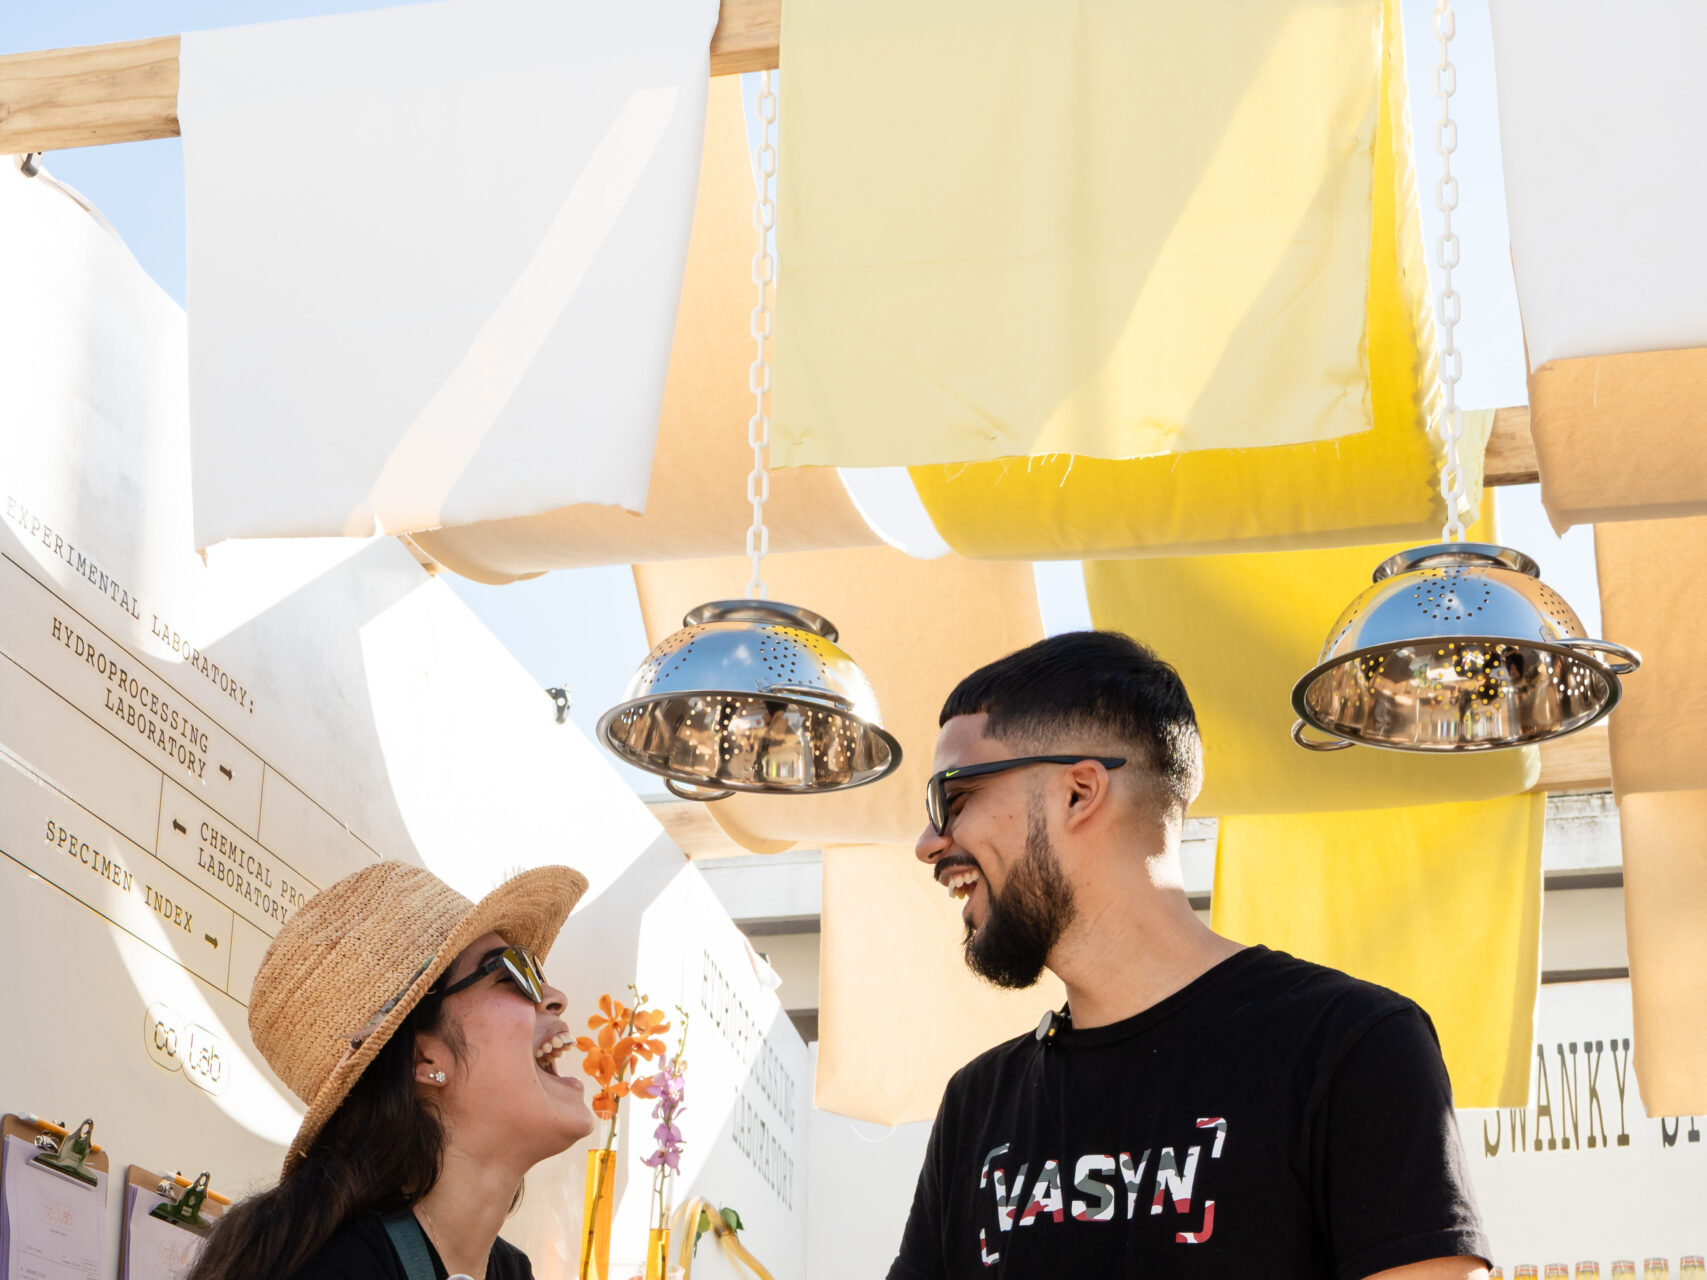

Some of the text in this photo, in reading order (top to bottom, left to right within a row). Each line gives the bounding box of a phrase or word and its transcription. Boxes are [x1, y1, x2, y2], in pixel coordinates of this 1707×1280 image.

[6, 496, 254, 714] EXPERIMENTAL LABORATORY:
[52, 617, 208, 754] HYDROPROCESSING
[104, 687, 206, 779] LABORATORY
[46, 820, 192, 933] SPECIMEN INDEX
[197, 846, 288, 925] LABORATORY
[200, 822, 272, 889] CHEMICAL
